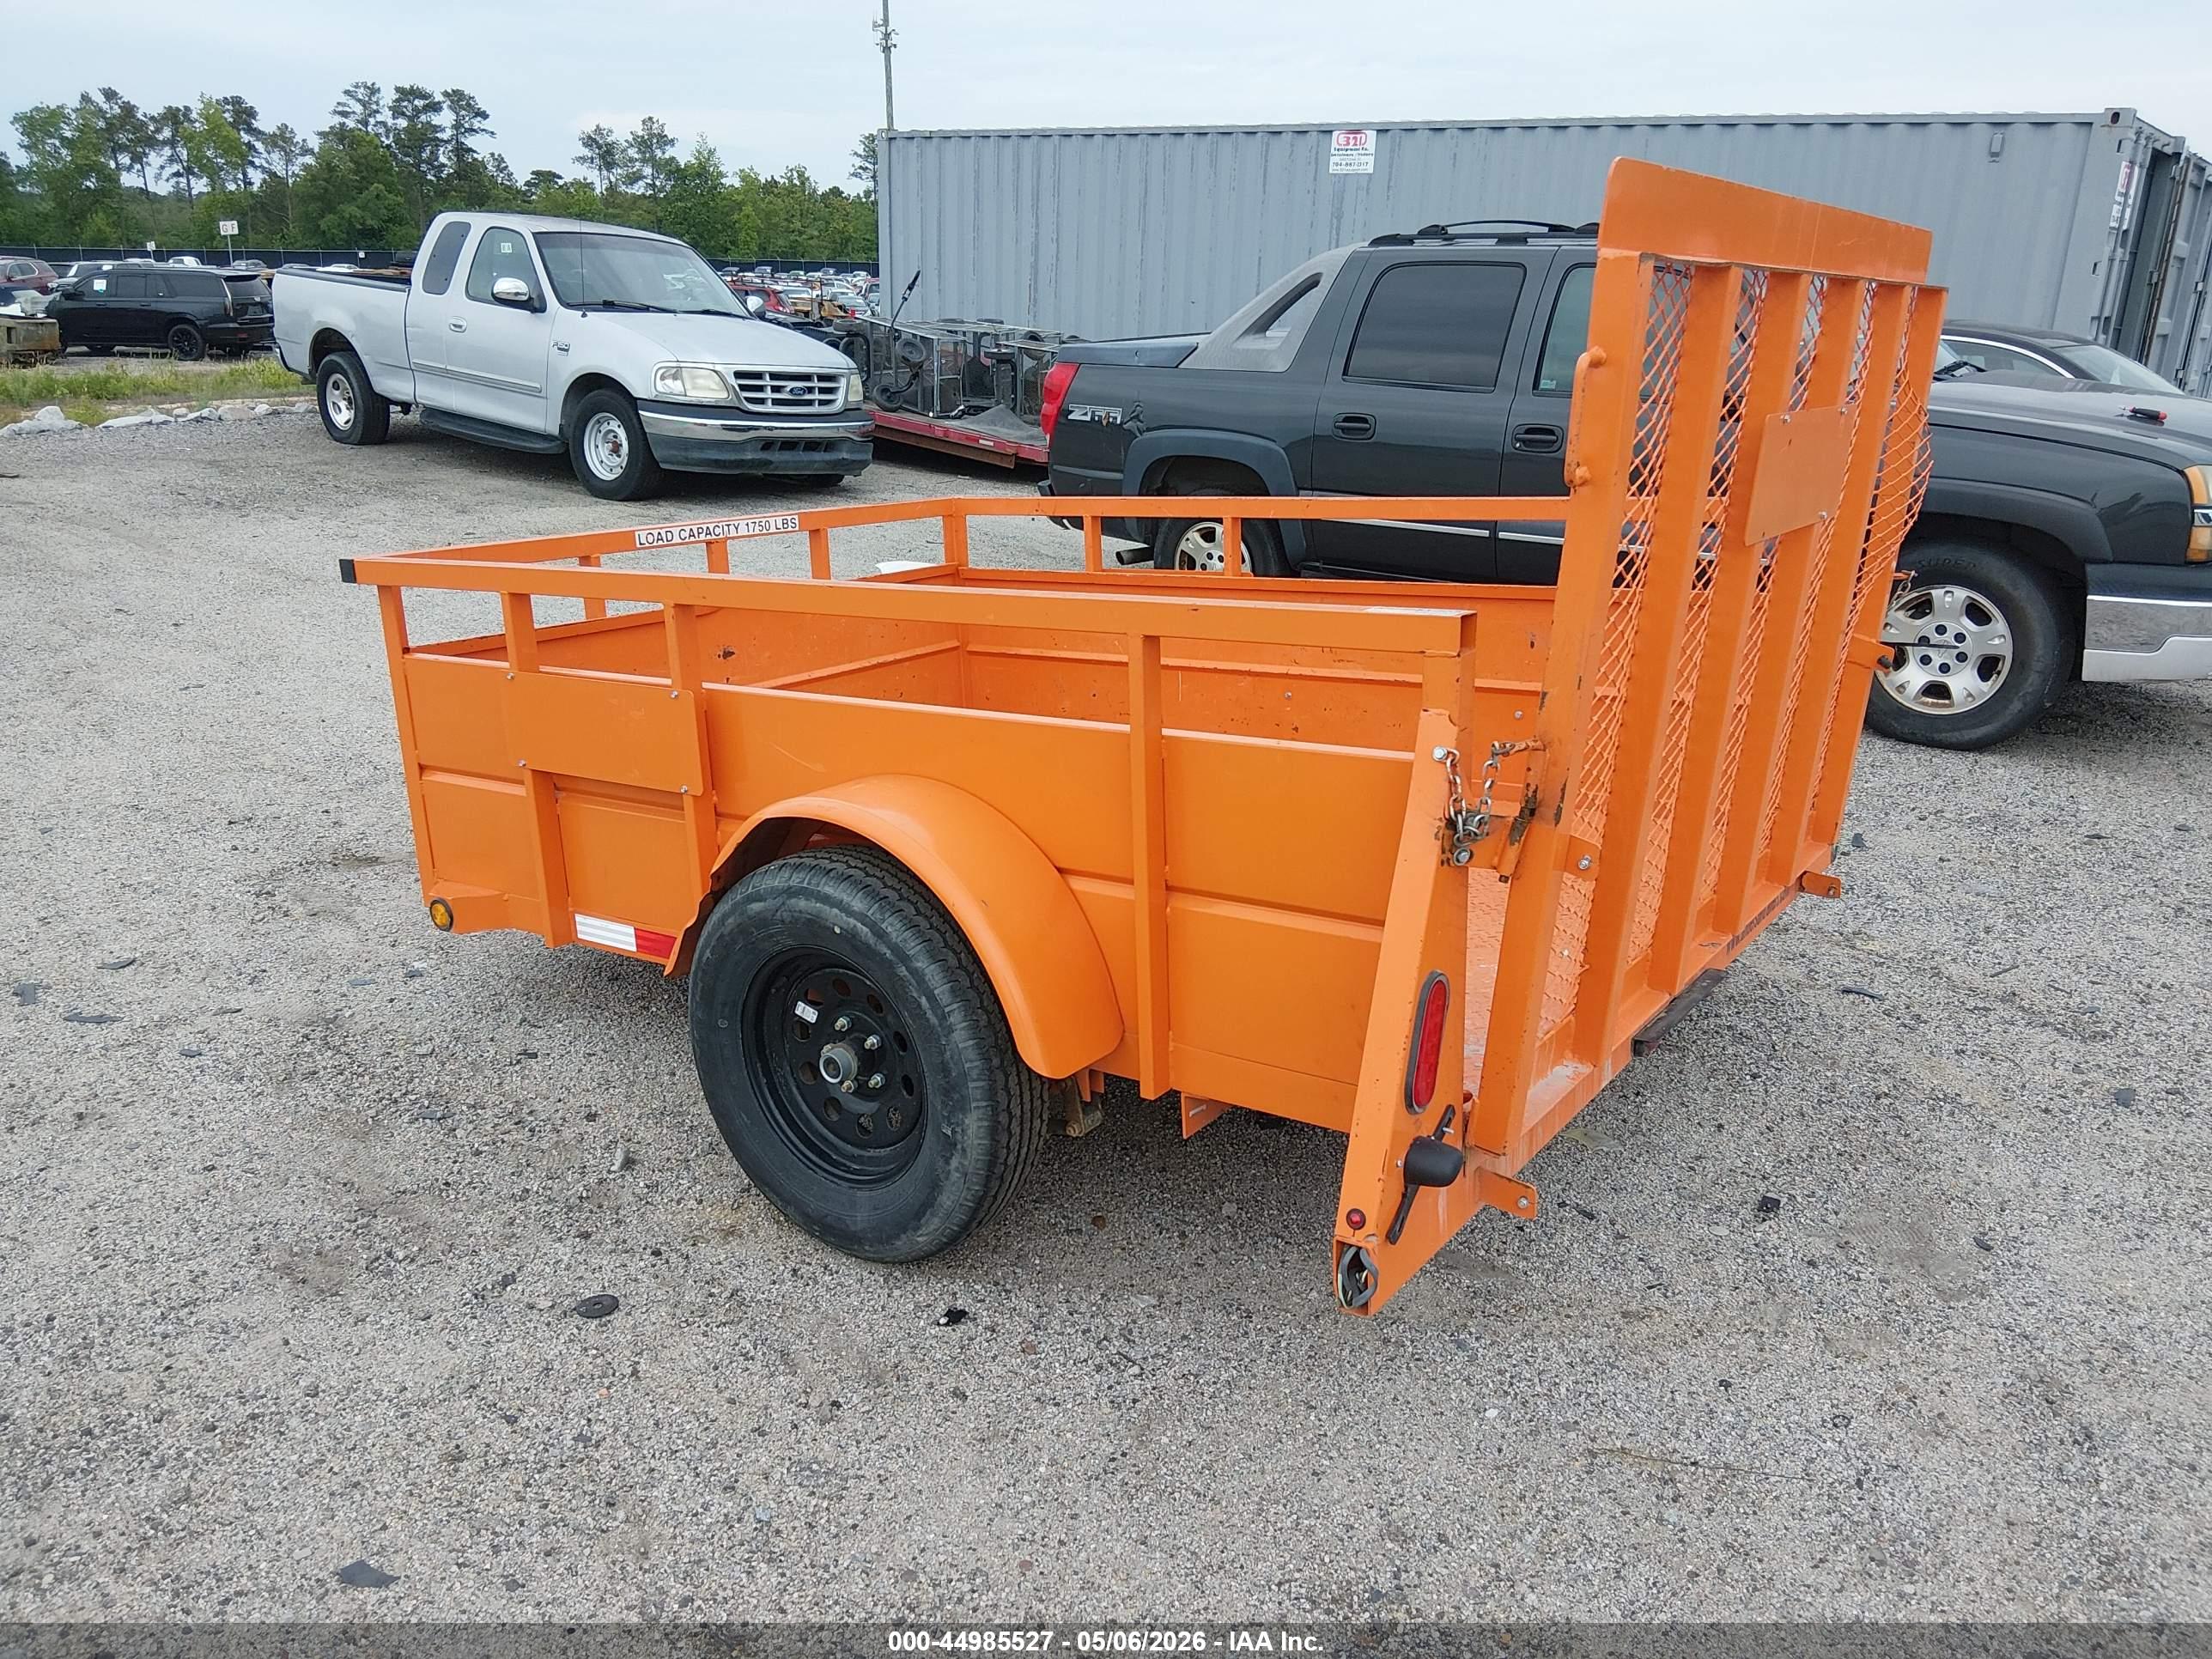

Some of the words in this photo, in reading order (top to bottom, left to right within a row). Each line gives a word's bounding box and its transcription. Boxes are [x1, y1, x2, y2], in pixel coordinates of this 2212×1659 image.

[637, 530, 674, 545] LOAD
[678, 522, 740, 541] CAPACITY
[744, 520, 771, 533] 1750
[775, 517, 797, 531] LBS
